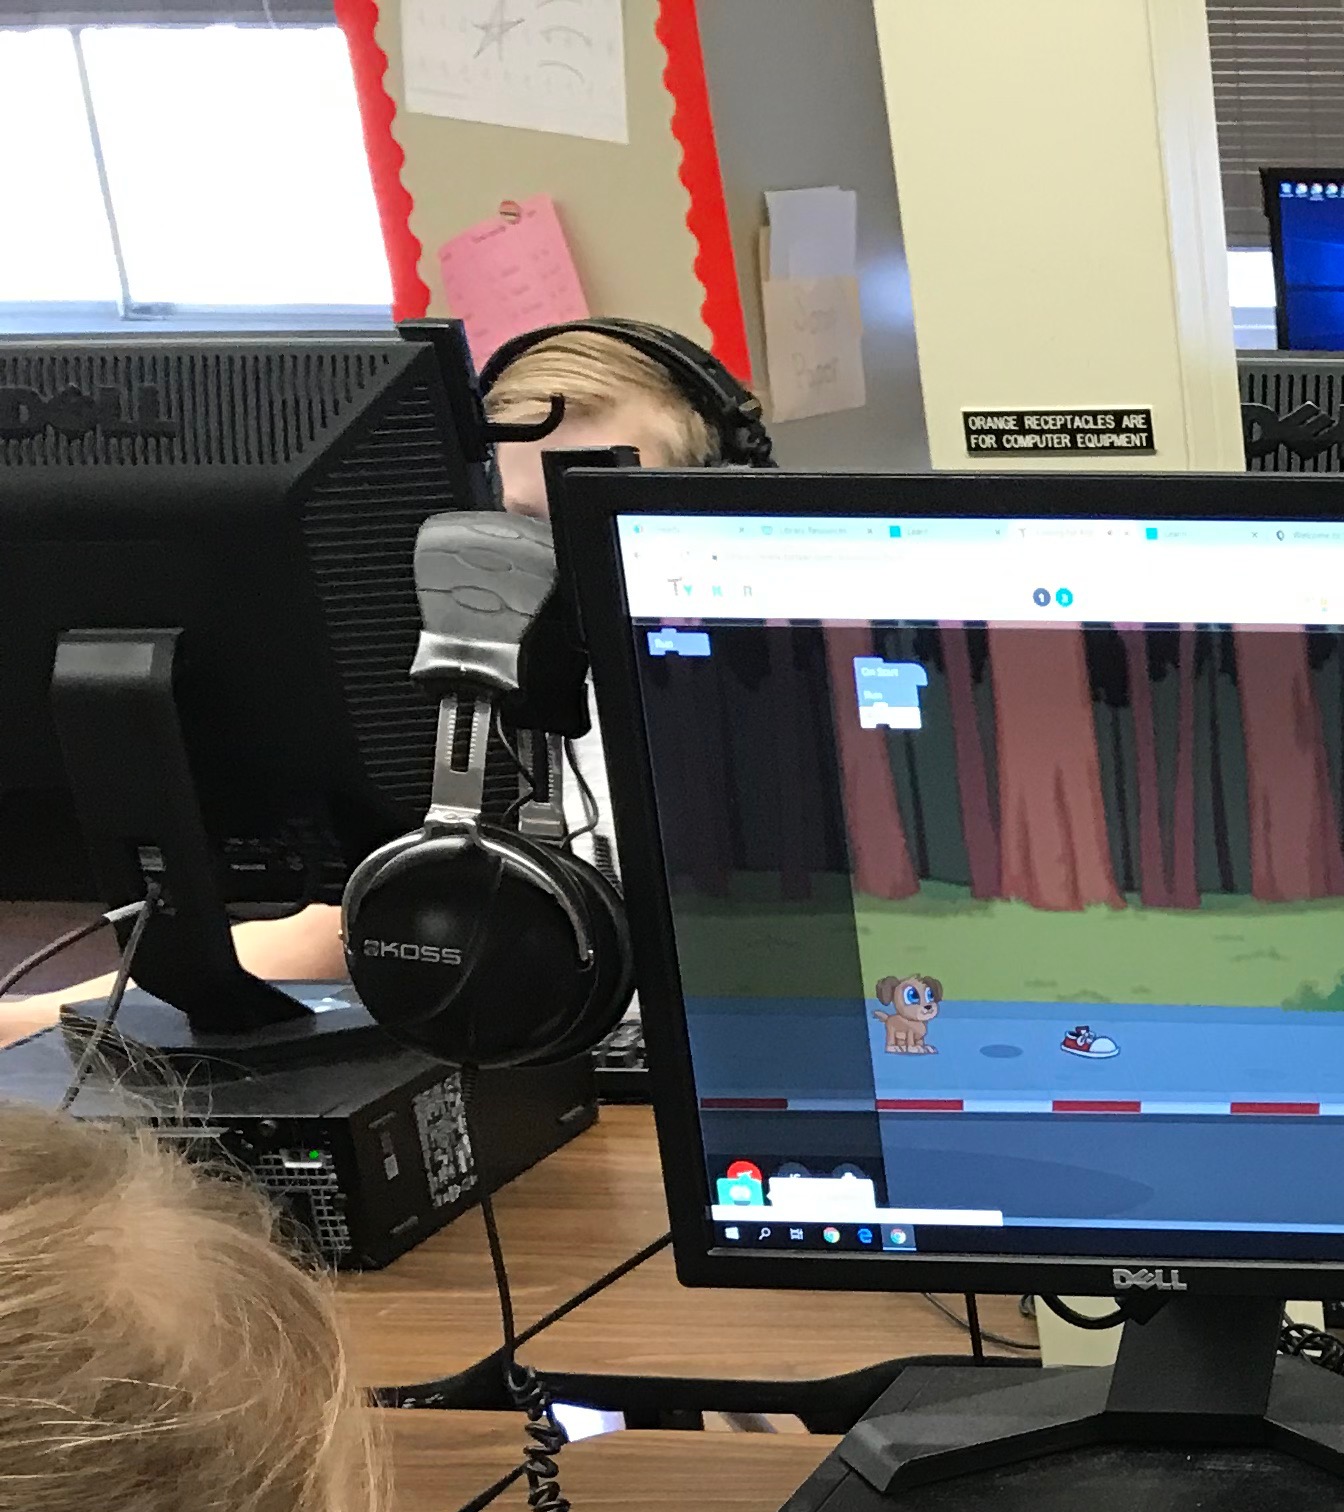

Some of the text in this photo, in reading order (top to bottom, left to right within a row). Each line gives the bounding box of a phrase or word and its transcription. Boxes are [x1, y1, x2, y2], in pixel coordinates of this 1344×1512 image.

[0, 385, 177, 439] DELL
[968, 414, 1147, 430] ORANGE RECEPTACLES ARE
[971, 433, 1148, 448] FOR COMPUTER EQUIPMENT
[381, 941, 461, 965] KOSS
[1113, 1268, 1187, 1290] DELL
